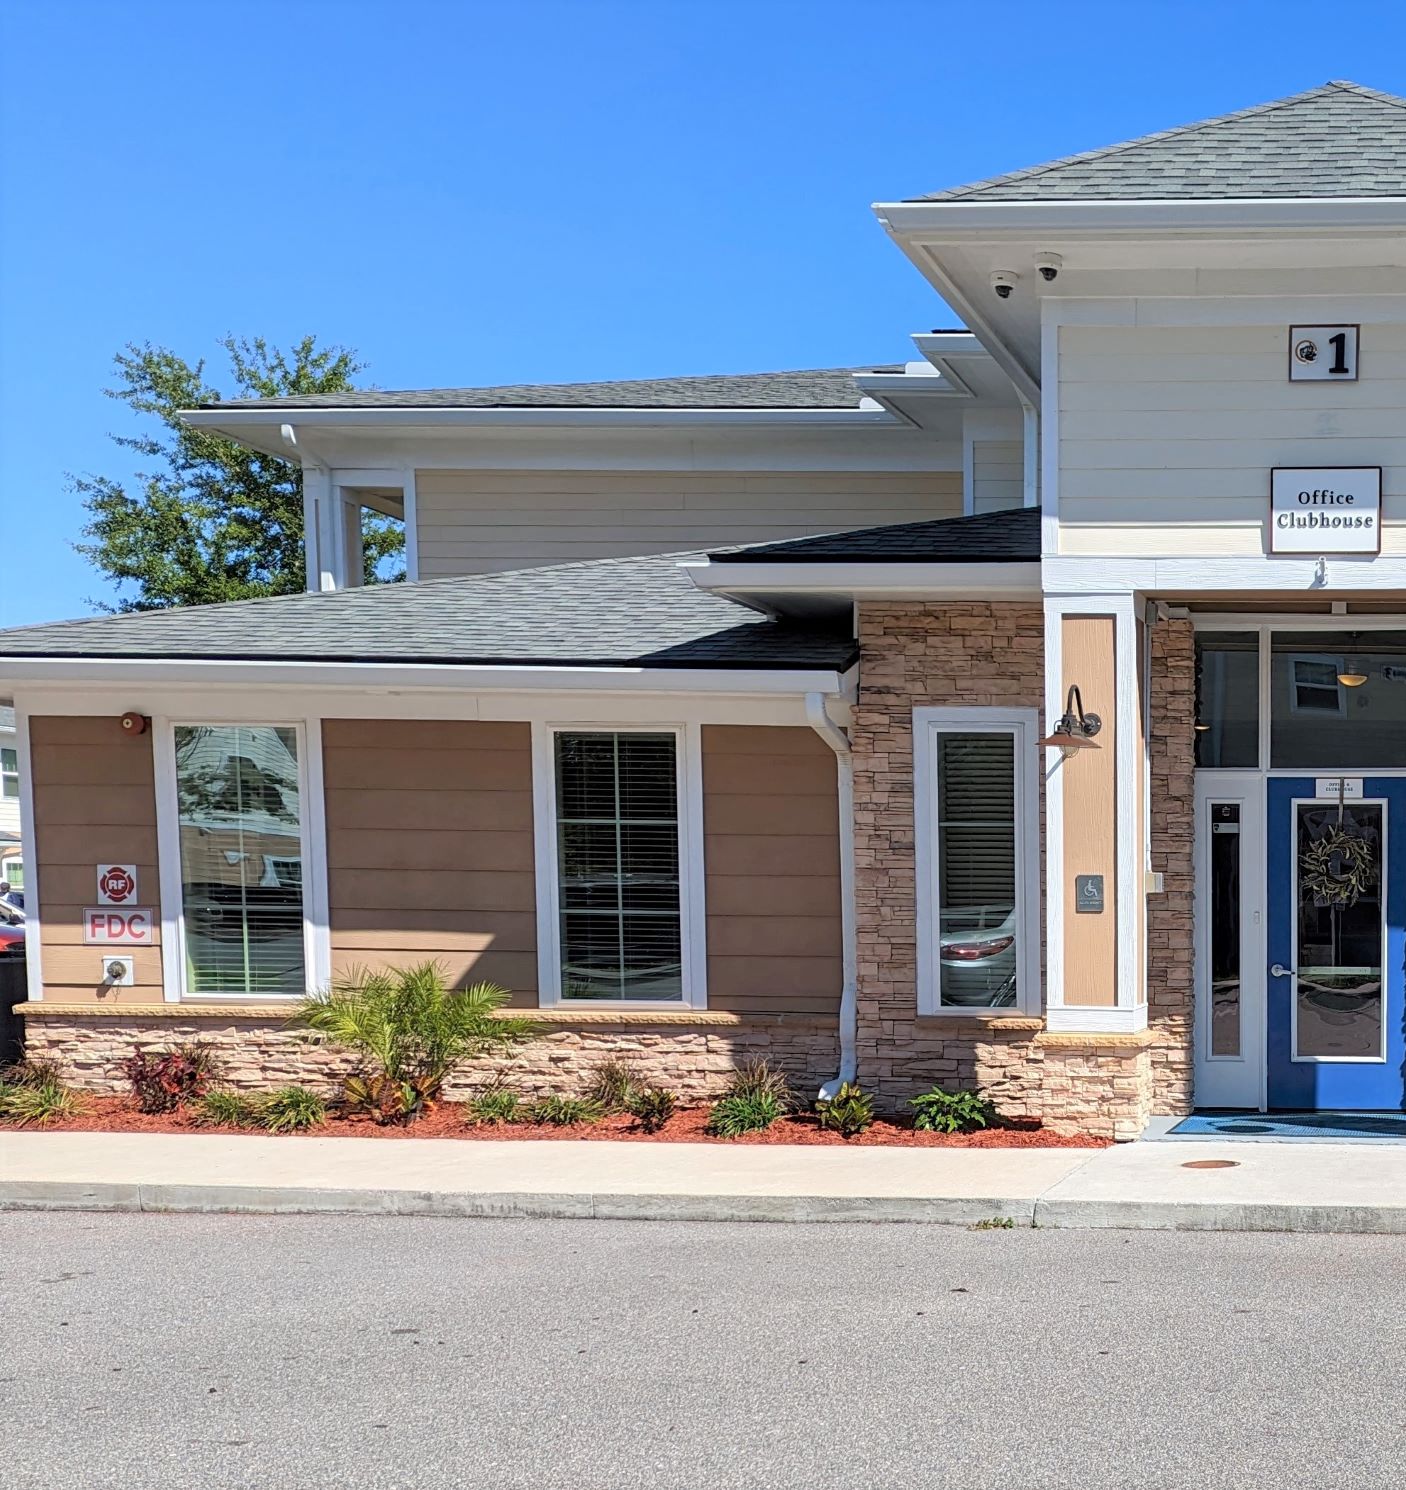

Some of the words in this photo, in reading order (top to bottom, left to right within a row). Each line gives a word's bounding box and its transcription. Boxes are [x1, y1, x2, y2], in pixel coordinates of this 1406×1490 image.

[1328, 332, 1350, 374] 1
[1297, 490, 1355, 505] Office
[1276, 511, 1374, 529] Clubhouse
[108, 879, 126, 890] RF
[90, 914, 146, 938] FDC
